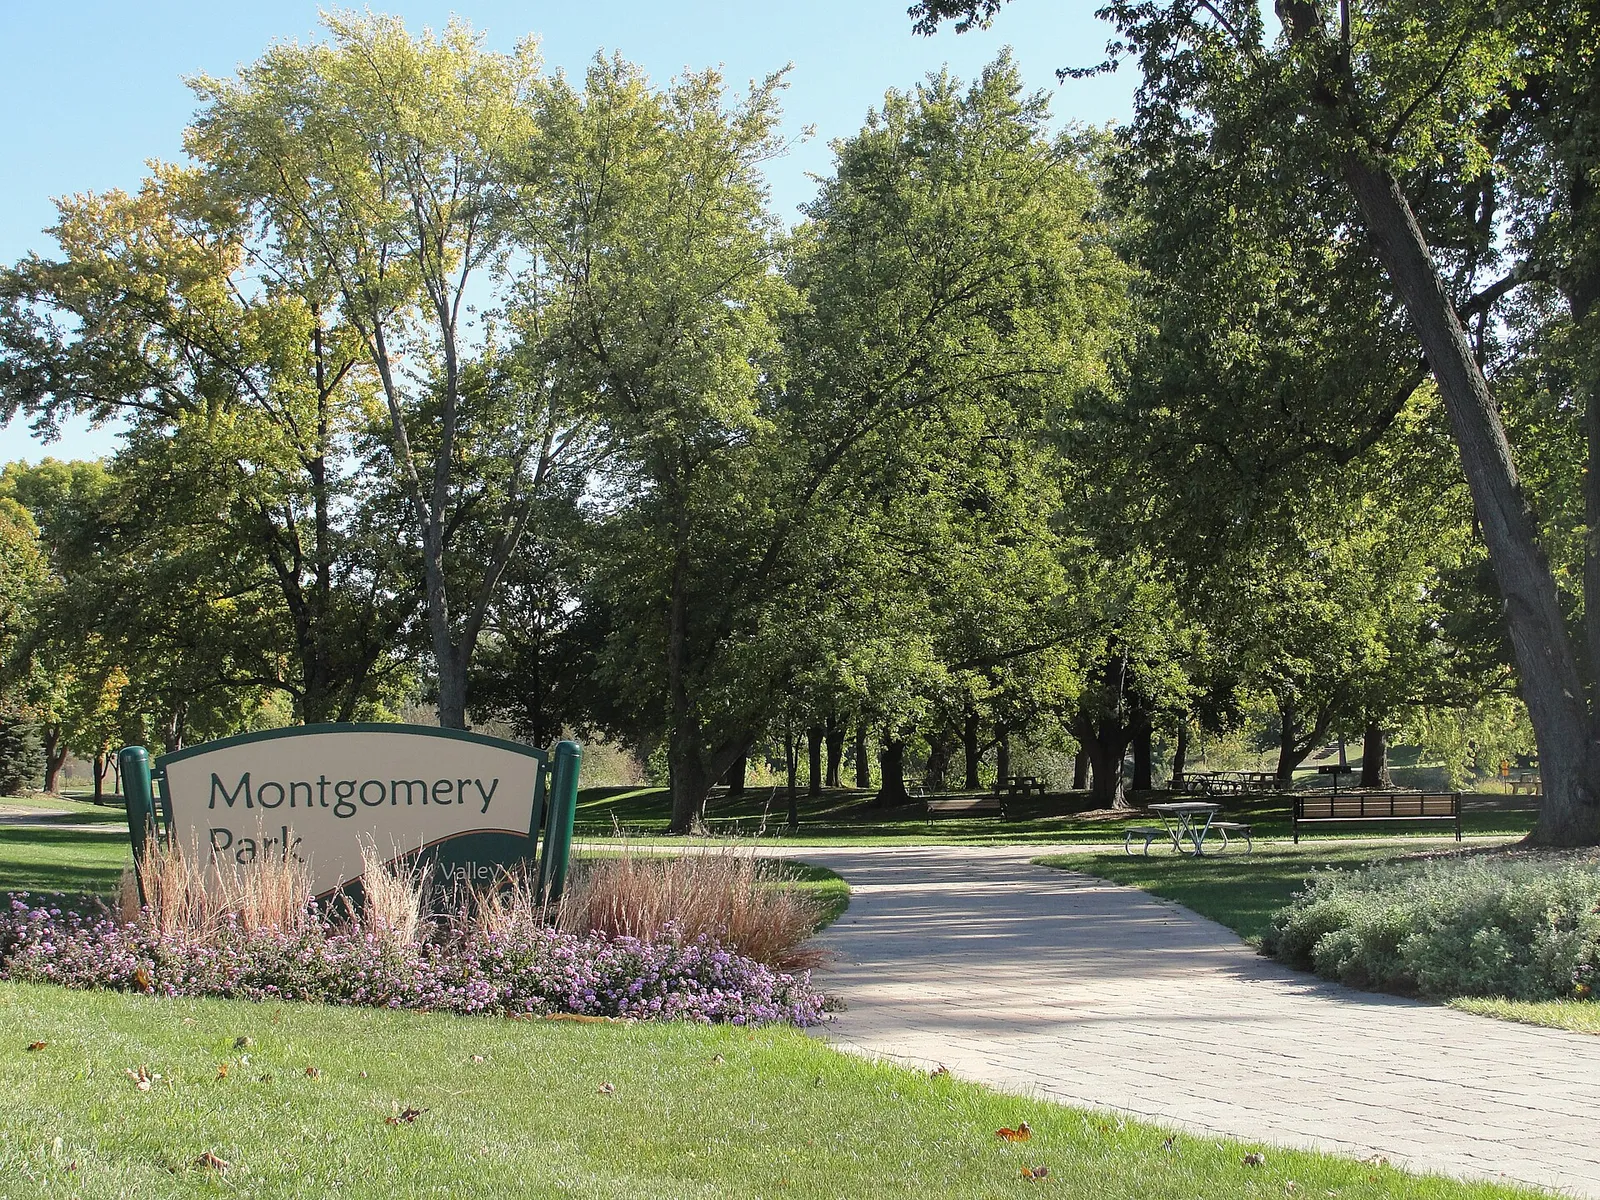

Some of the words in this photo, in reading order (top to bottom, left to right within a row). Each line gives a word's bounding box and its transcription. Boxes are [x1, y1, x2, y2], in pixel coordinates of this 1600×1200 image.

[208, 771, 499, 818] Montgomery
[209, 825, 304, 865] Park
[440, 861, 501, 884] Valley
